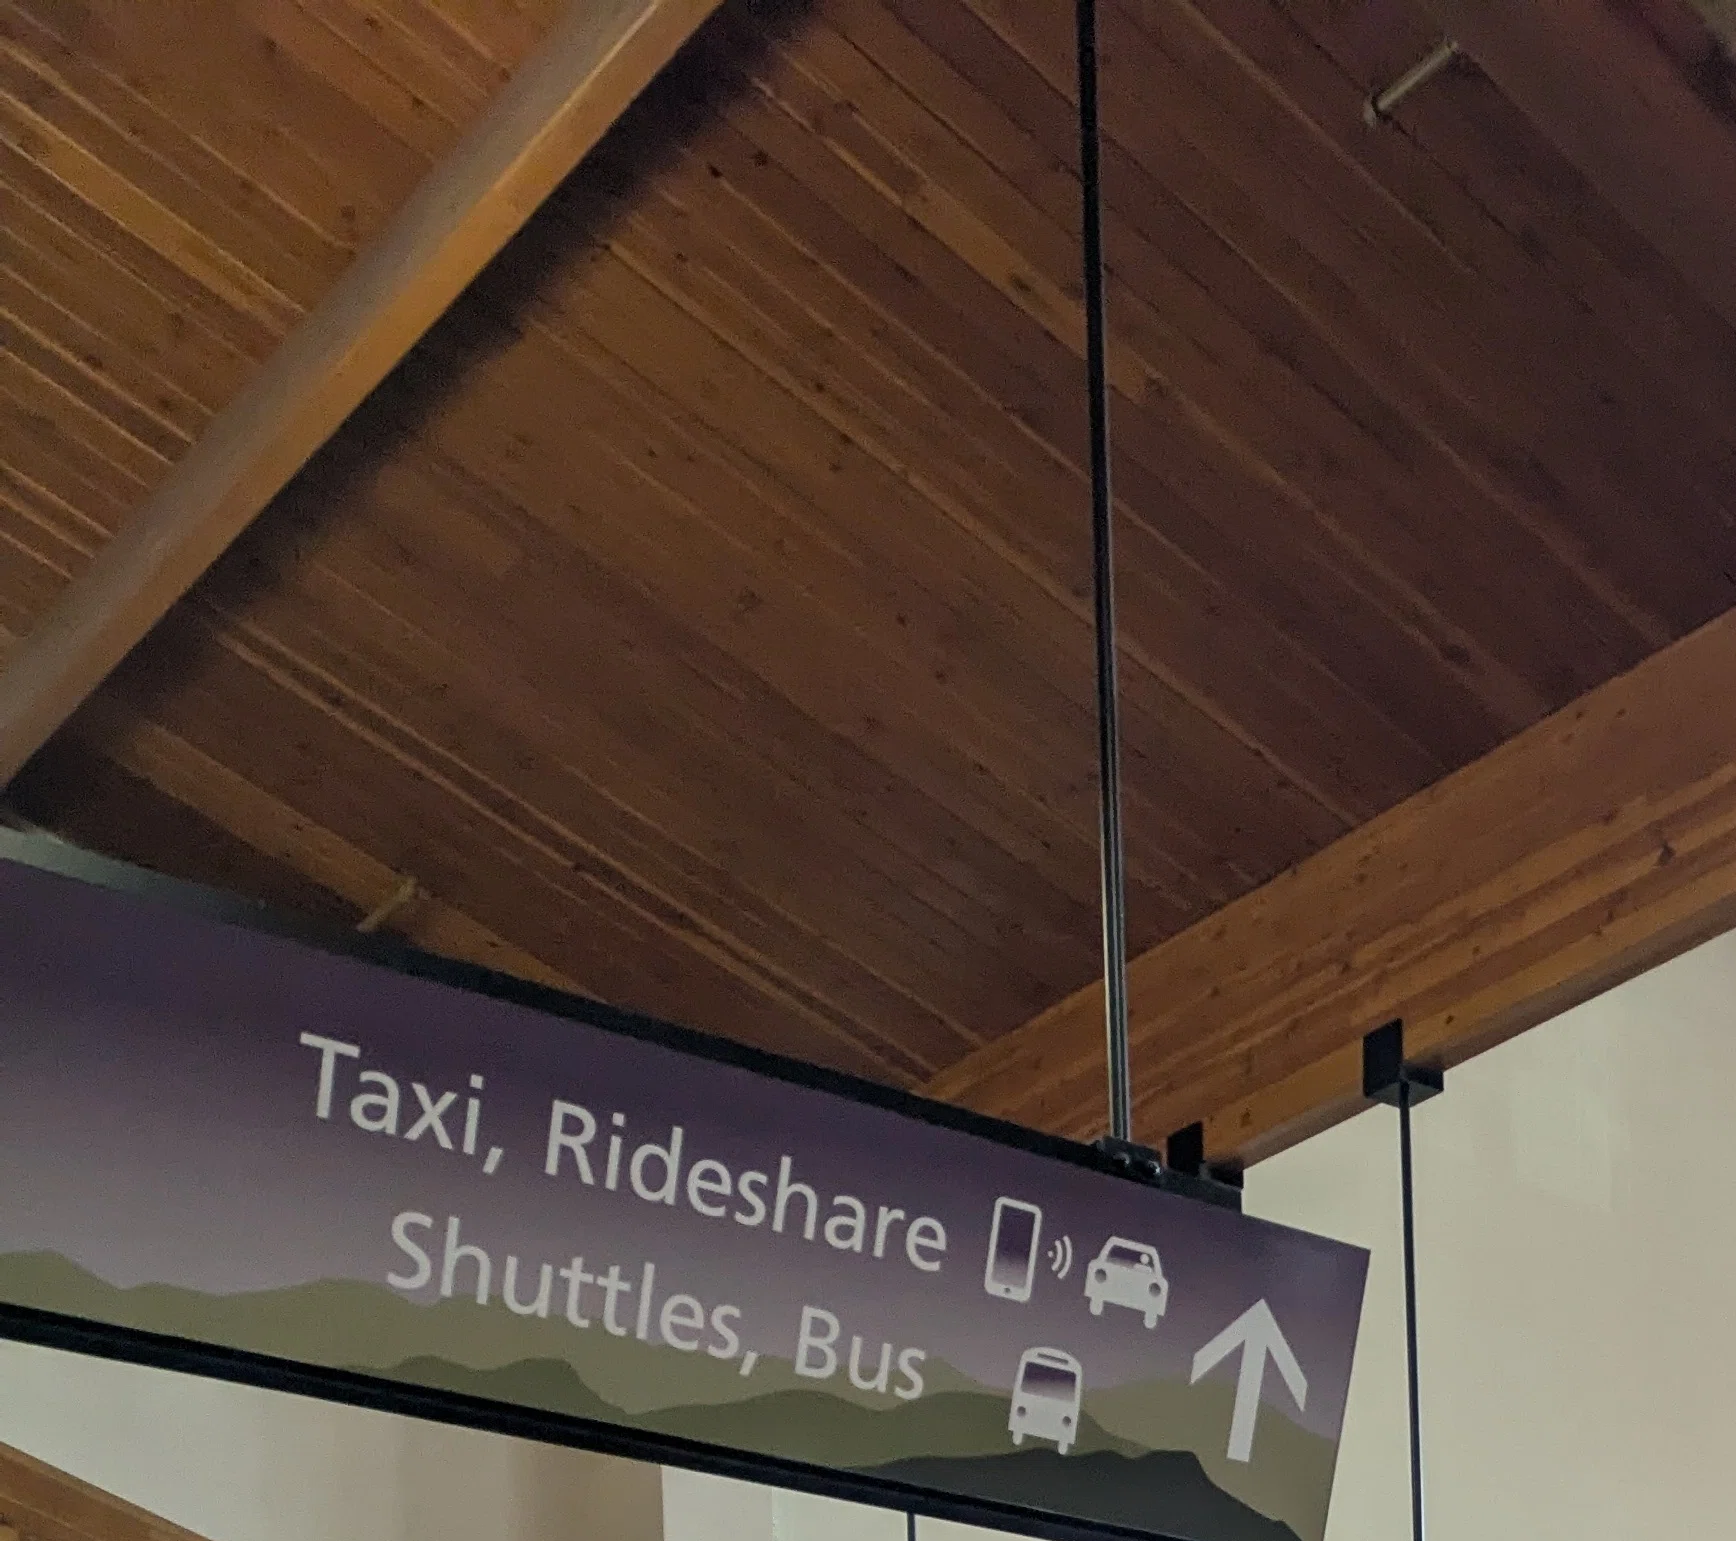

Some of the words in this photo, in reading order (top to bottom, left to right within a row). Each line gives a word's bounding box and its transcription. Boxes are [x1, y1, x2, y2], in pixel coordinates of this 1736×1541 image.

[298, 1032, 506, 1175] Taxi,
[544, 1098, 948, 1273] Rideshare
[387, 1209, 760, 1377] Shuttles,
[795, 1304, 927, 1402] Bus
